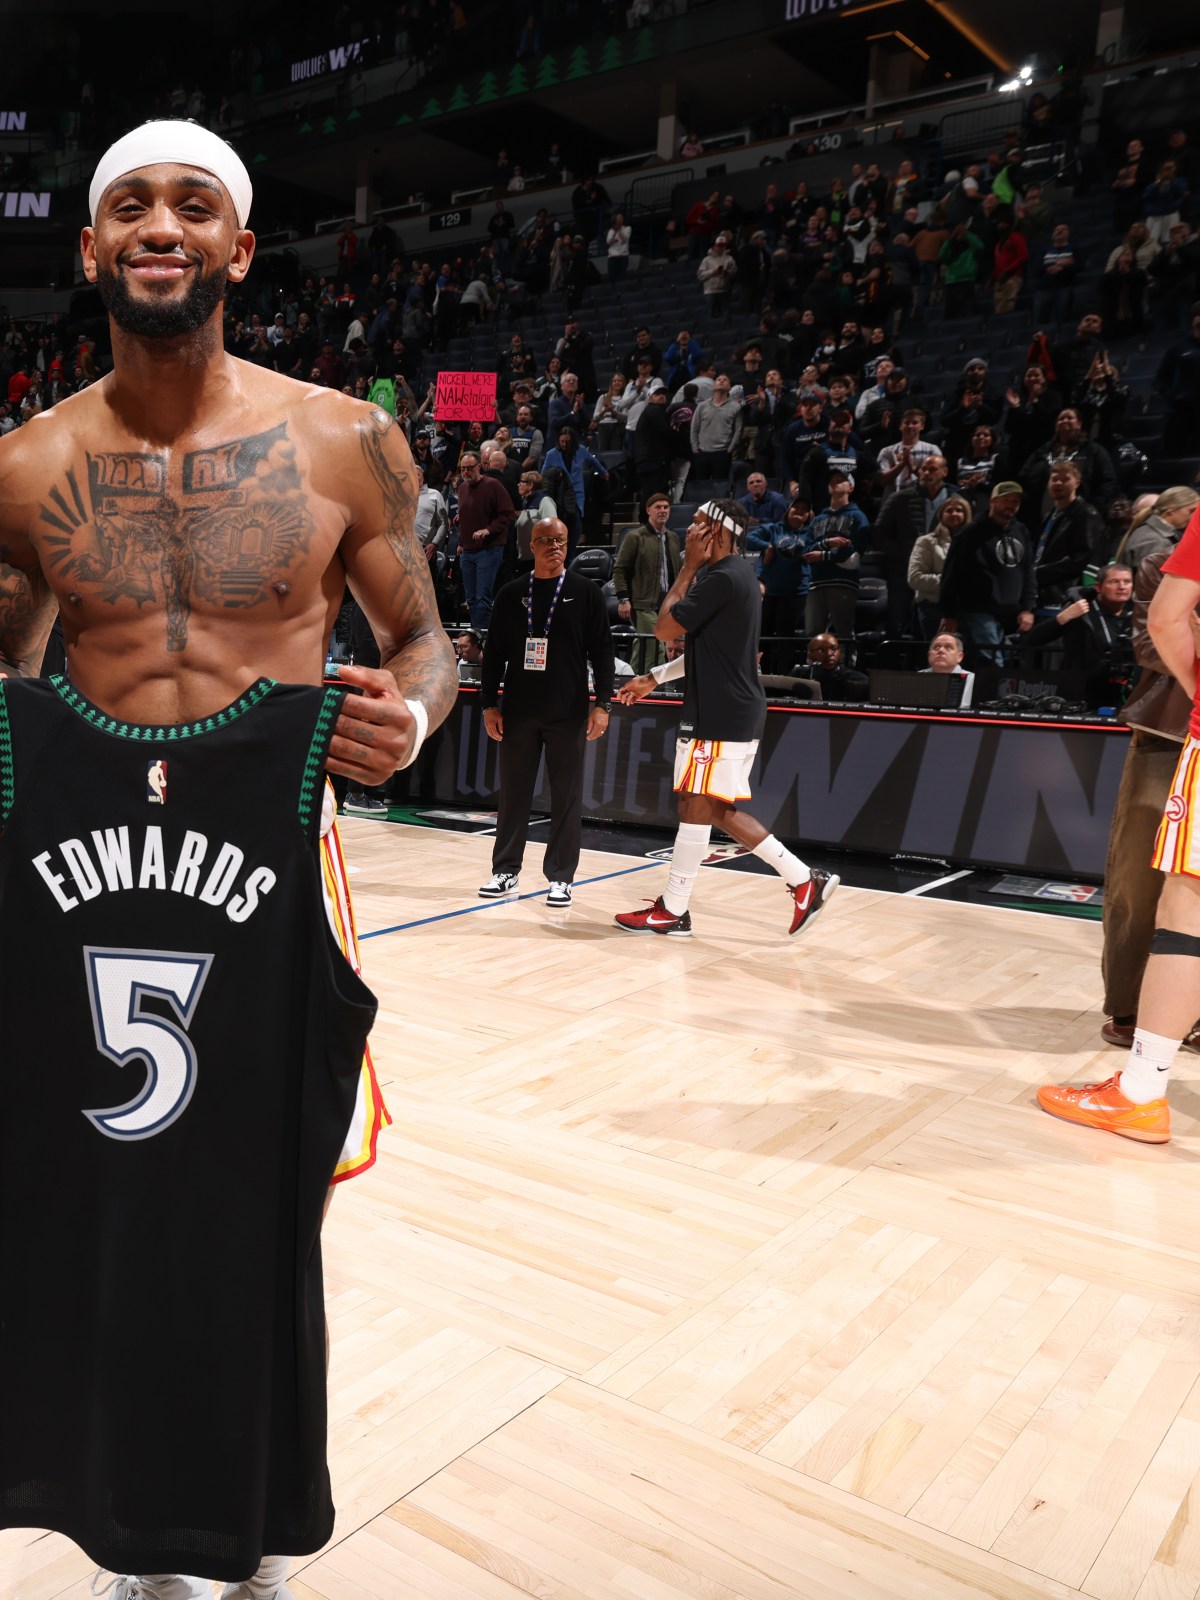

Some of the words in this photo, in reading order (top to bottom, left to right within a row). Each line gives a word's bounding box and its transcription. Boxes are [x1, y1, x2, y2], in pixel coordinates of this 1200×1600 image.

[440, 212, 460, 227] 129
[435, 408, 463, 419] FOR
[467, 407, 494, 420] YOU
[744, 713, 1133, 876] WIN
[31, 825, 277, 923] EDWARDS
[81, 945, 215, 1142] 5
